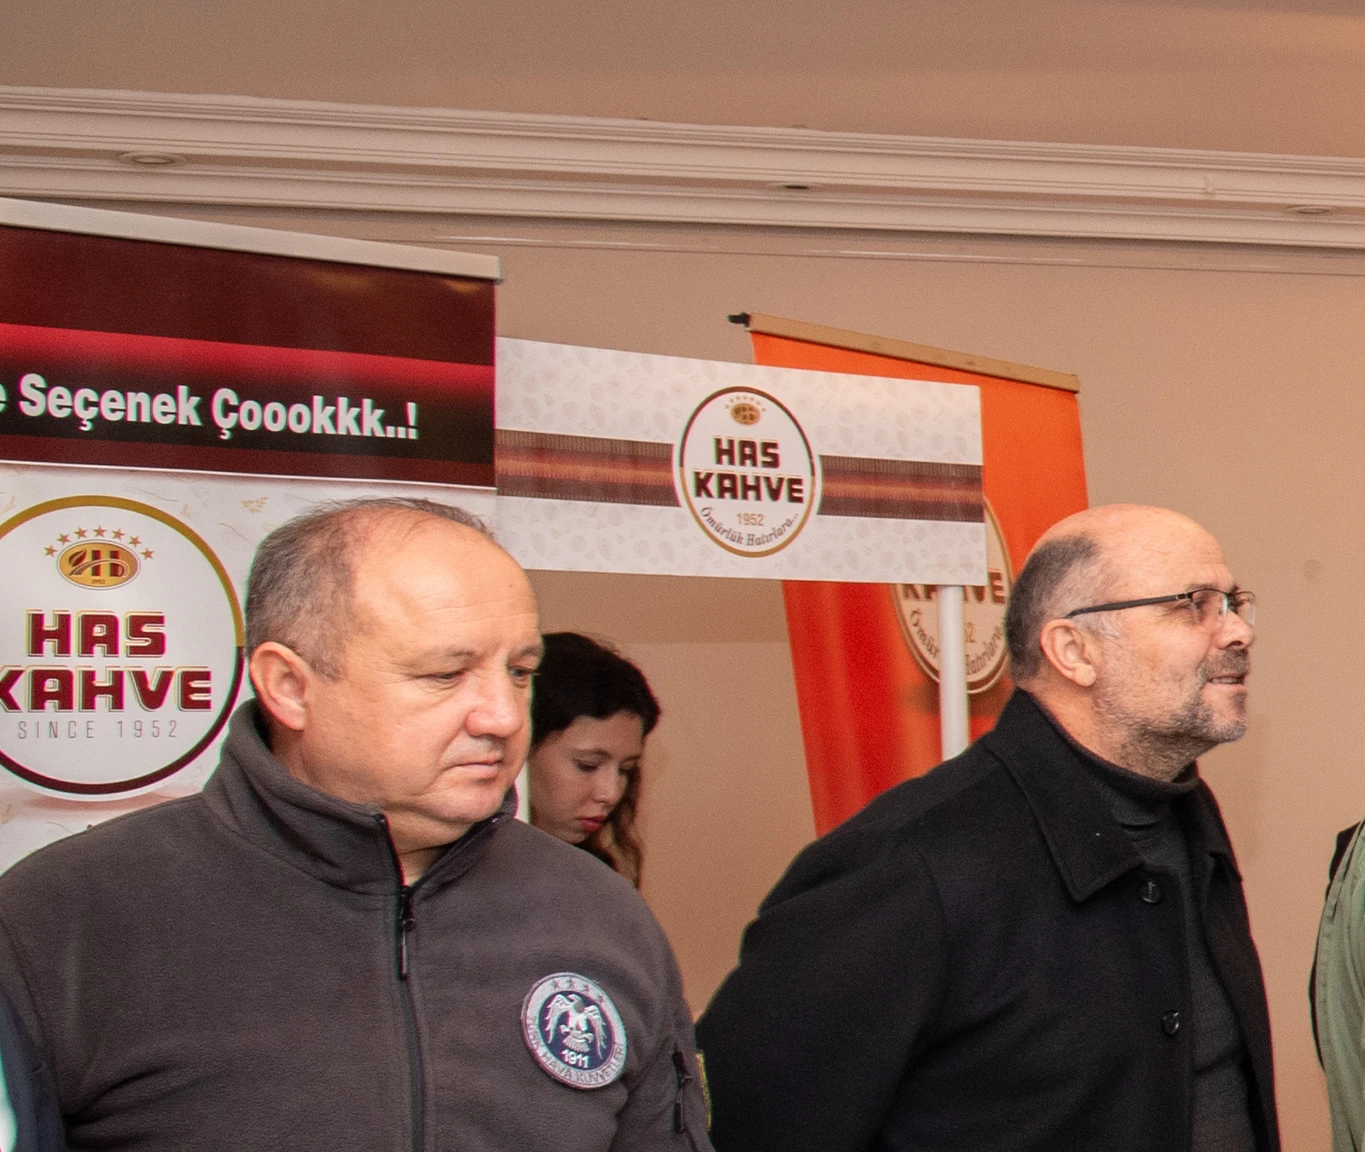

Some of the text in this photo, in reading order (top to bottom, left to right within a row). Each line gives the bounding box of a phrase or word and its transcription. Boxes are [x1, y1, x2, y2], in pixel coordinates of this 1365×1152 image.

[20, 373, 202, 431] Seçenek
[211, 387, 418, 440] Çoookkk..!
[714, 435, 780, 469] HAS
[692, 468, 804, 504] KAHVE
[736, 513, 764, 527] 1952
[26, 609, 167, 658] HAS
[0, 665, 213, 713] KAHVE
[18, 719, 178, 740] SINCE 1952
[562, 1049, 590, 1069] 1911
